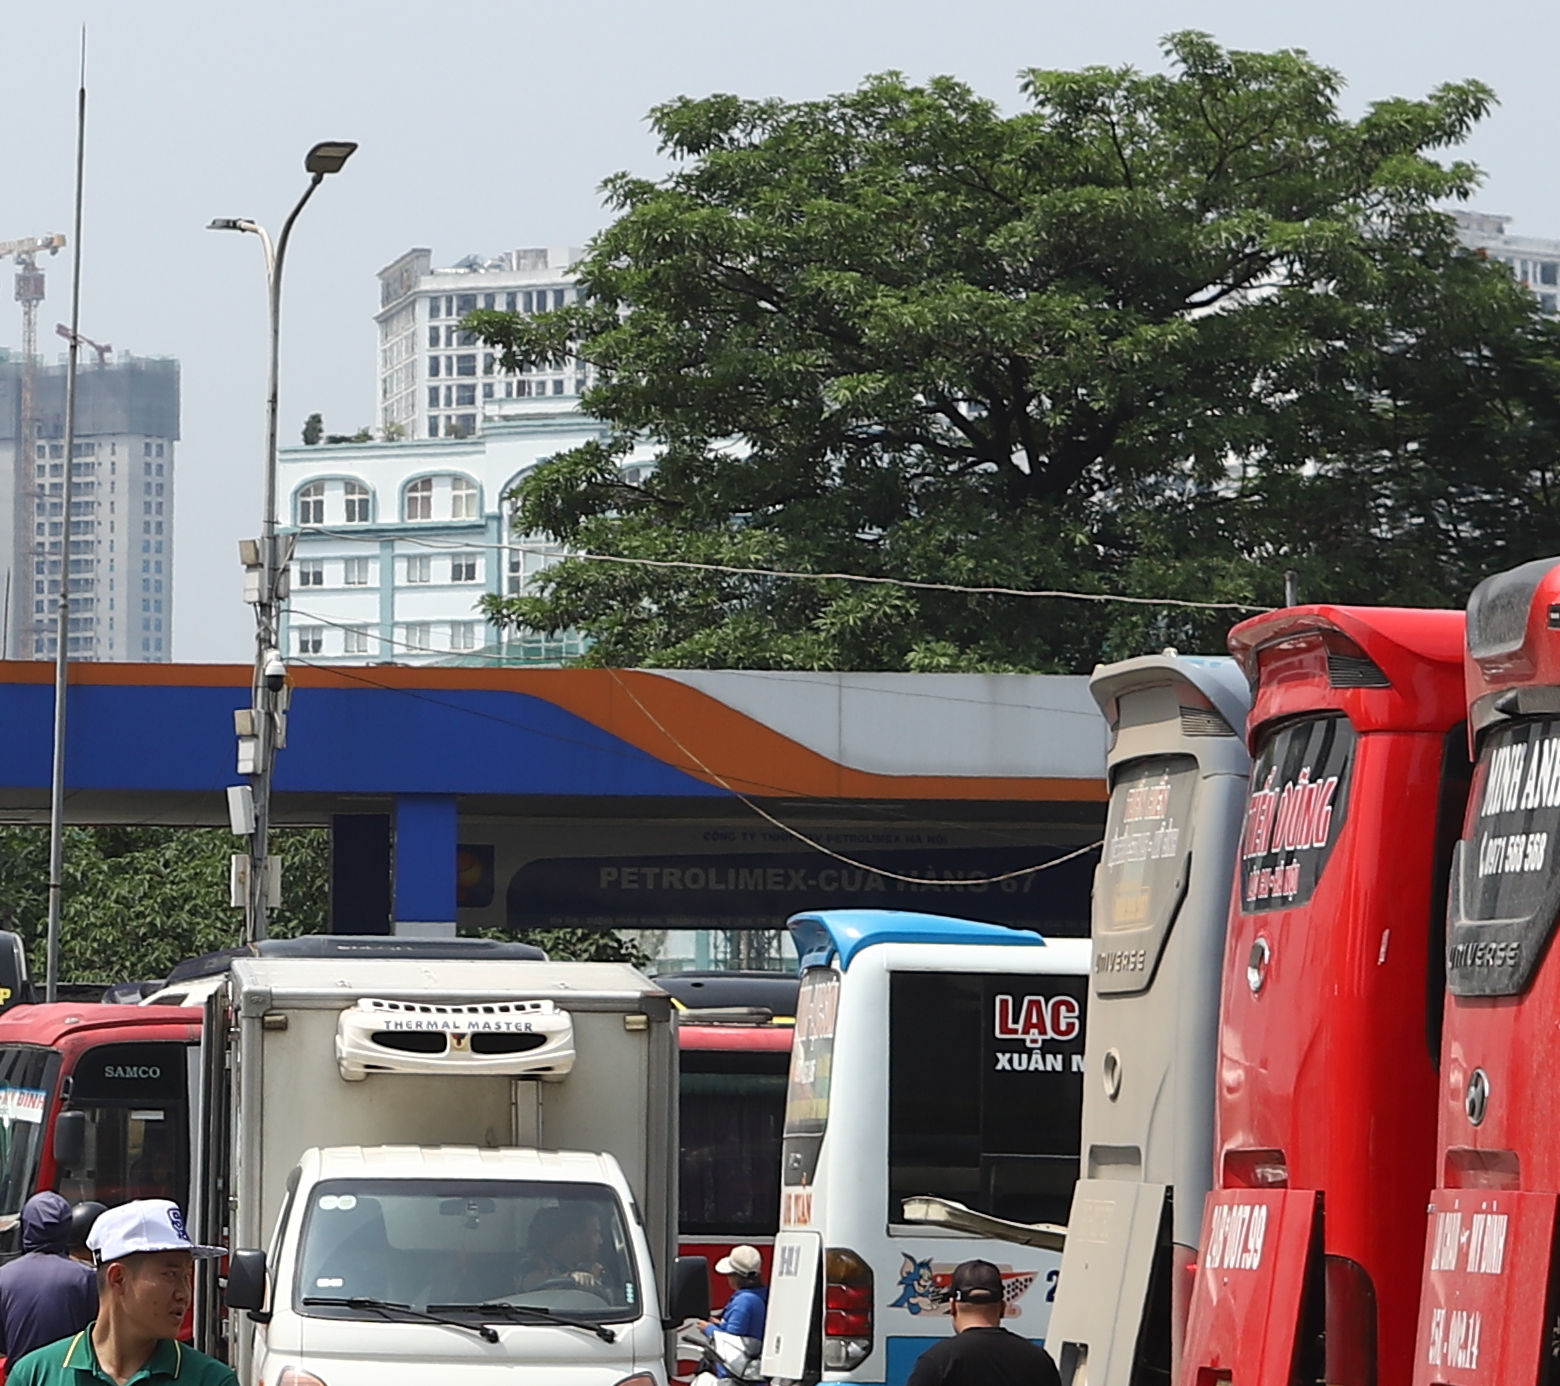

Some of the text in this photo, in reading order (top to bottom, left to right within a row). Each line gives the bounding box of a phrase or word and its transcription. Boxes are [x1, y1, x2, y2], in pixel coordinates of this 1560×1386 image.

[383, 1019, 534, 1033] THERMAL MASTER
[994, 994, 1080, 1048] LẠC
[994, 1049, 1064, 1073] XUÂN
[104, 1065, 161, 1079] SAMCO
